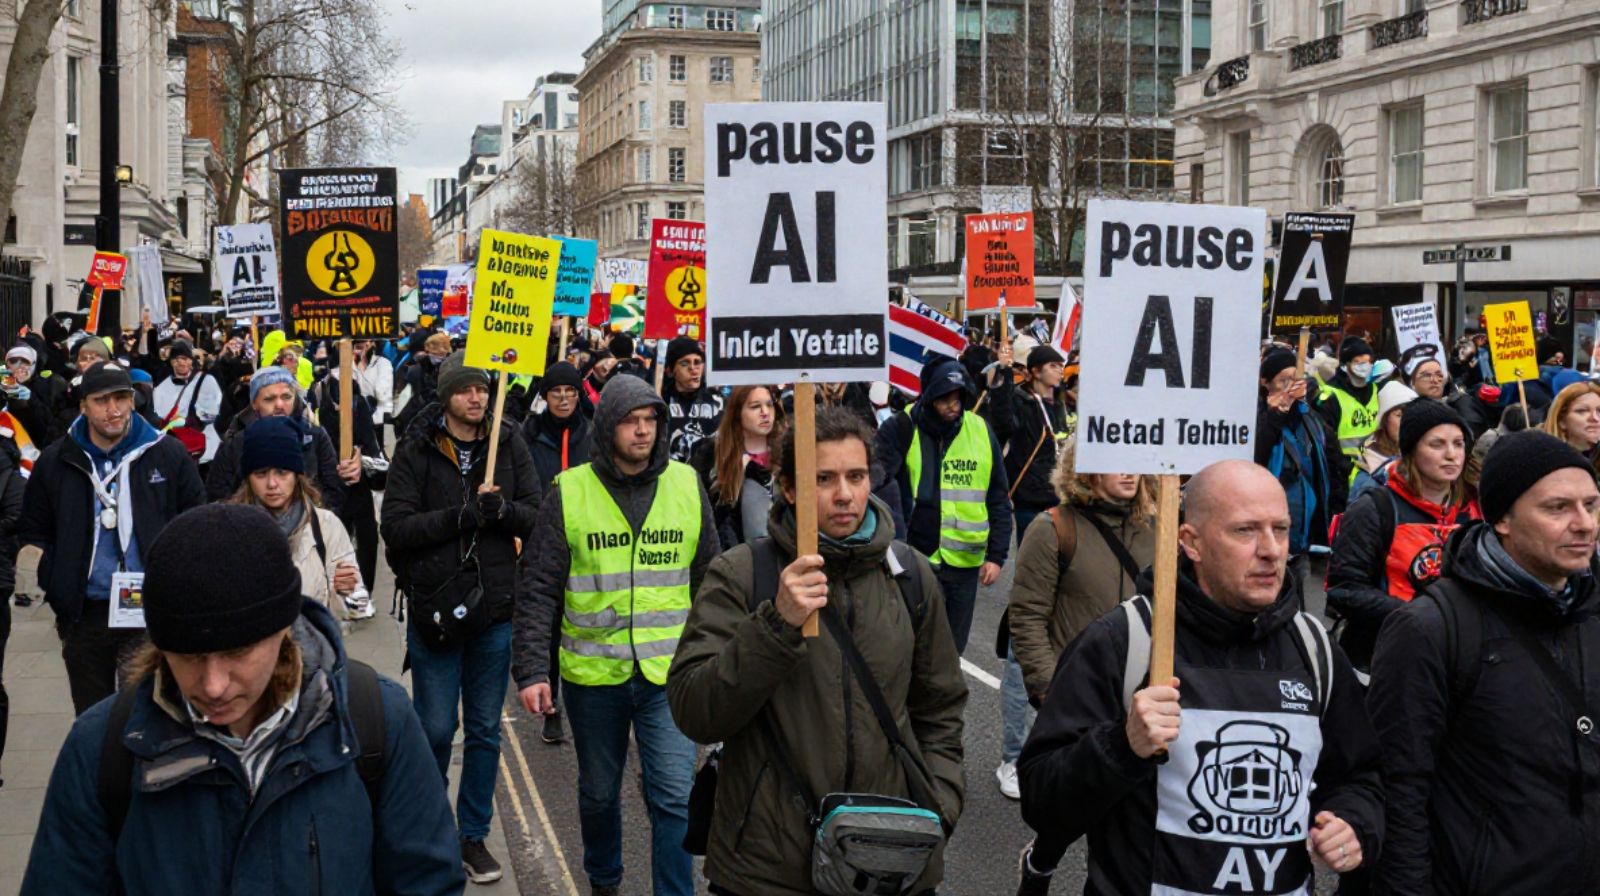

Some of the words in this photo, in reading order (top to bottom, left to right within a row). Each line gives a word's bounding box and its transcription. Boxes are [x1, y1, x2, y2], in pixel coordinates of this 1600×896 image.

[717, 120, 875, 177] pause
[750, 190, 837, 284] AI
[1099, 221, 1254, 278] pause
[232, 254, 263, 287] AI
[1124, 295, 1214, 389] AI
[1087, 415, 1165, 446] Netad
[1212, 847, 1288, 893] AY
